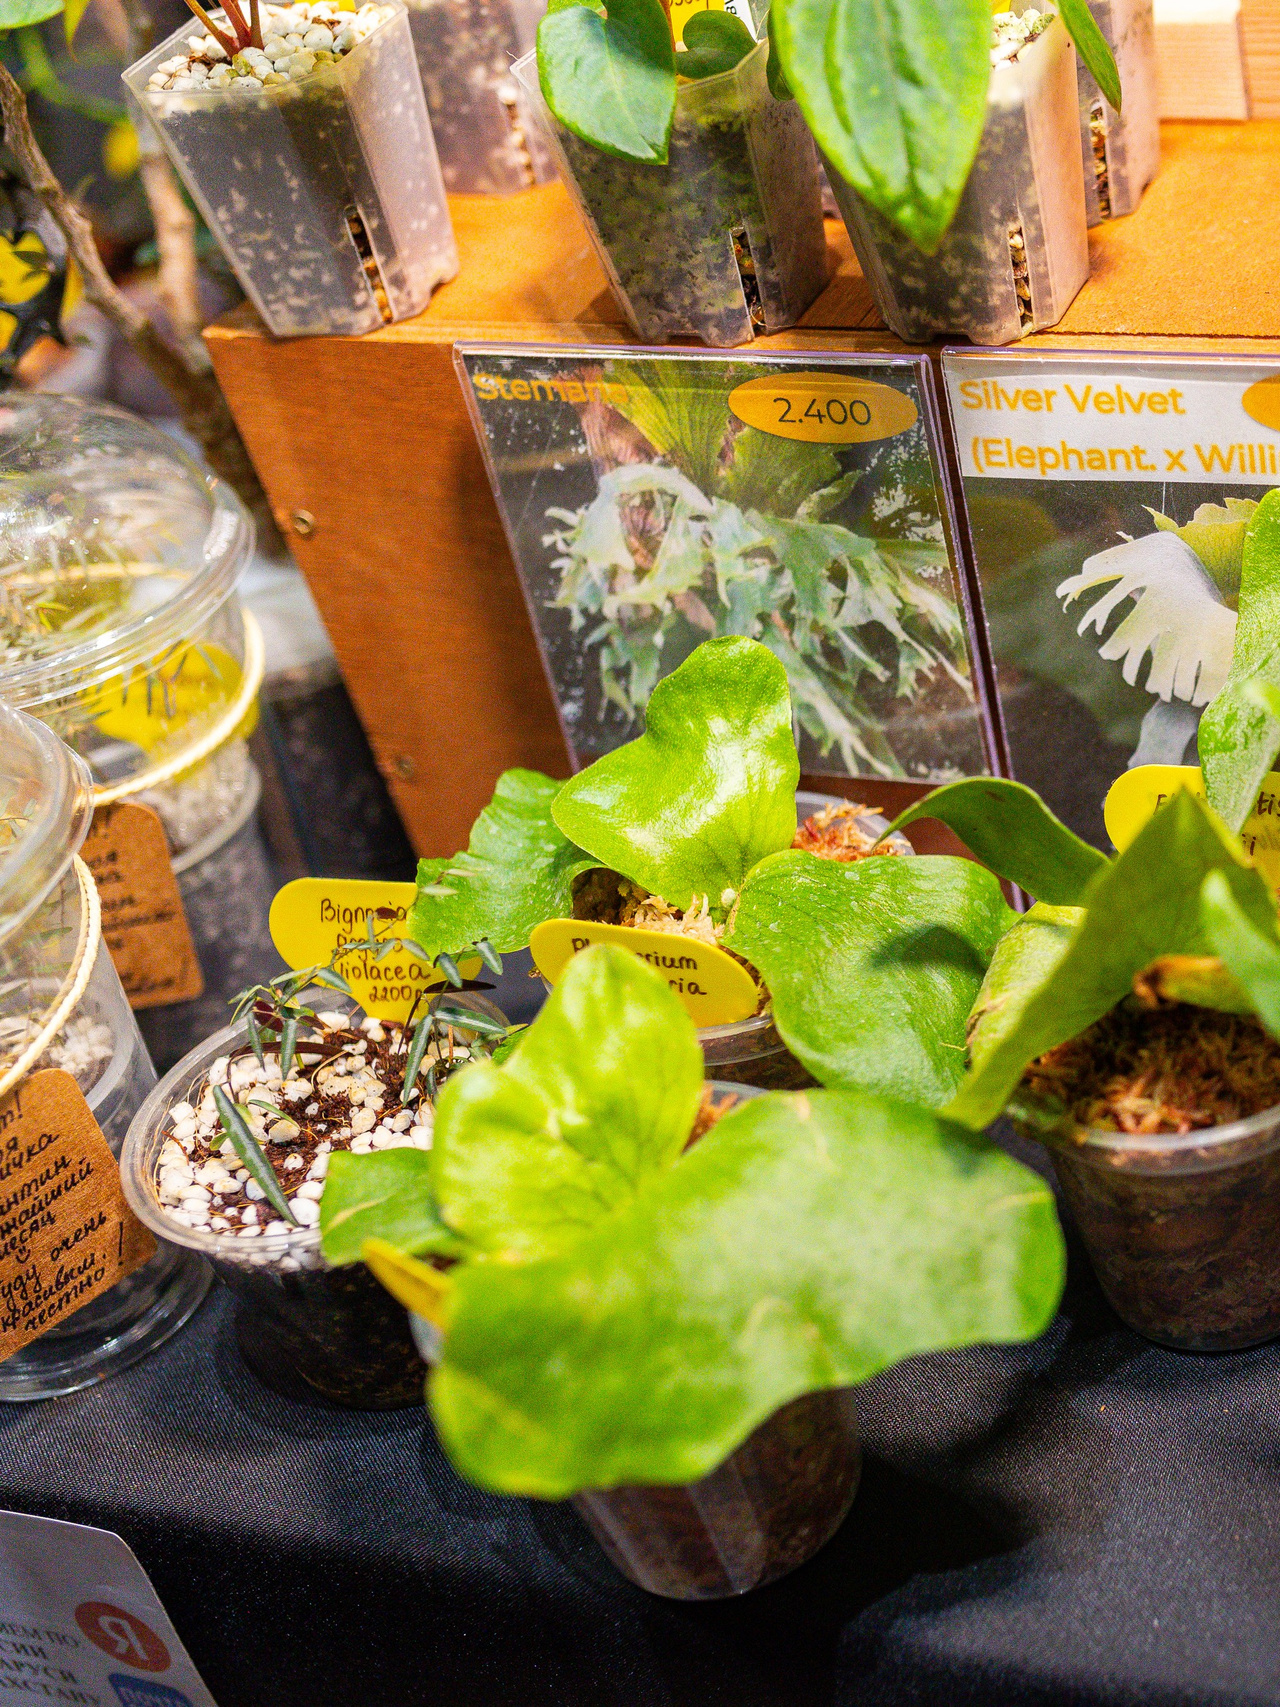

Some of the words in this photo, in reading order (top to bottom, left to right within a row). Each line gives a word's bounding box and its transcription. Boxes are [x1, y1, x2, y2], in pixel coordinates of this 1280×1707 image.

[772, 396, 871, 427] 2.400
[959, 380, 1057, 412] Silver
[1063, 383, 1186, 415] Velvet
[972, 437, 1158, 477] (Elephant.
[1165, 449, 1188, 473] x
